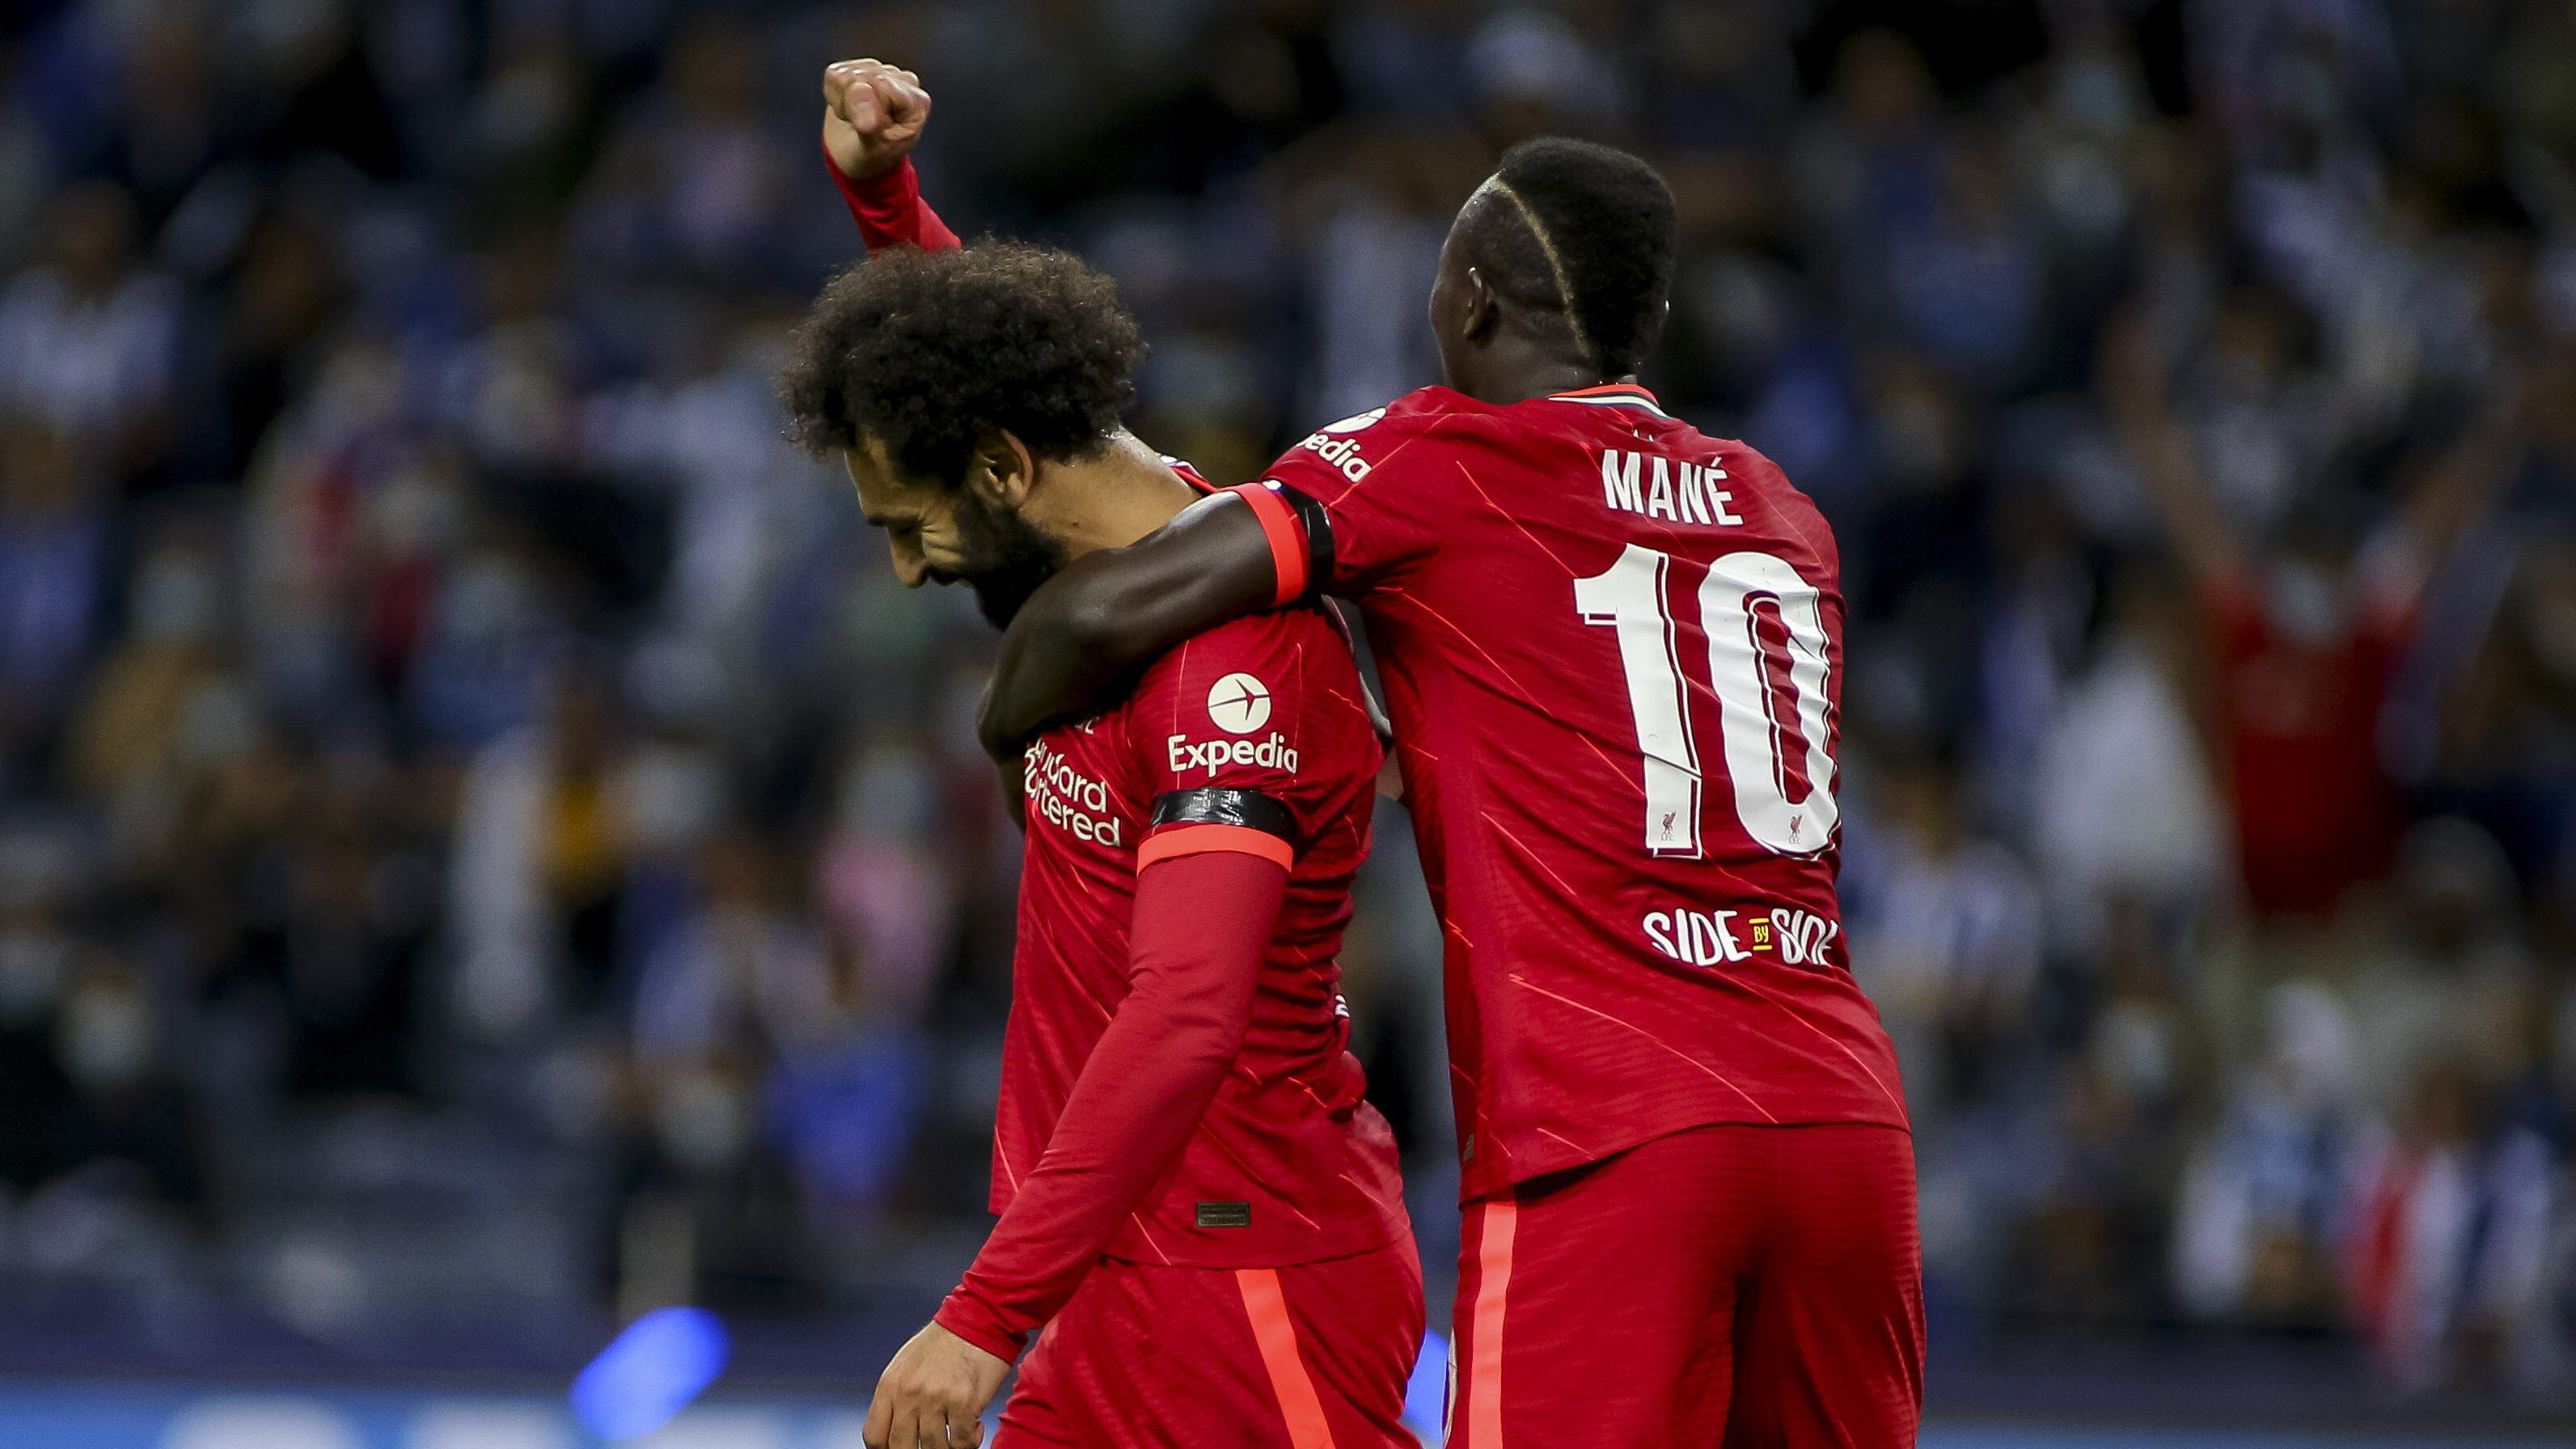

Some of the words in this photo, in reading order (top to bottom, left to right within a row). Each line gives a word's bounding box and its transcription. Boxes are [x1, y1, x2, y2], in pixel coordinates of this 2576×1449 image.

[1601, 448, 1744, 525] MANÉ
[1573, 542, 1840, 861] 10
[1168, 731, 1298, 777] Expedia
[1643, 909, 1753, 966] SIDE
